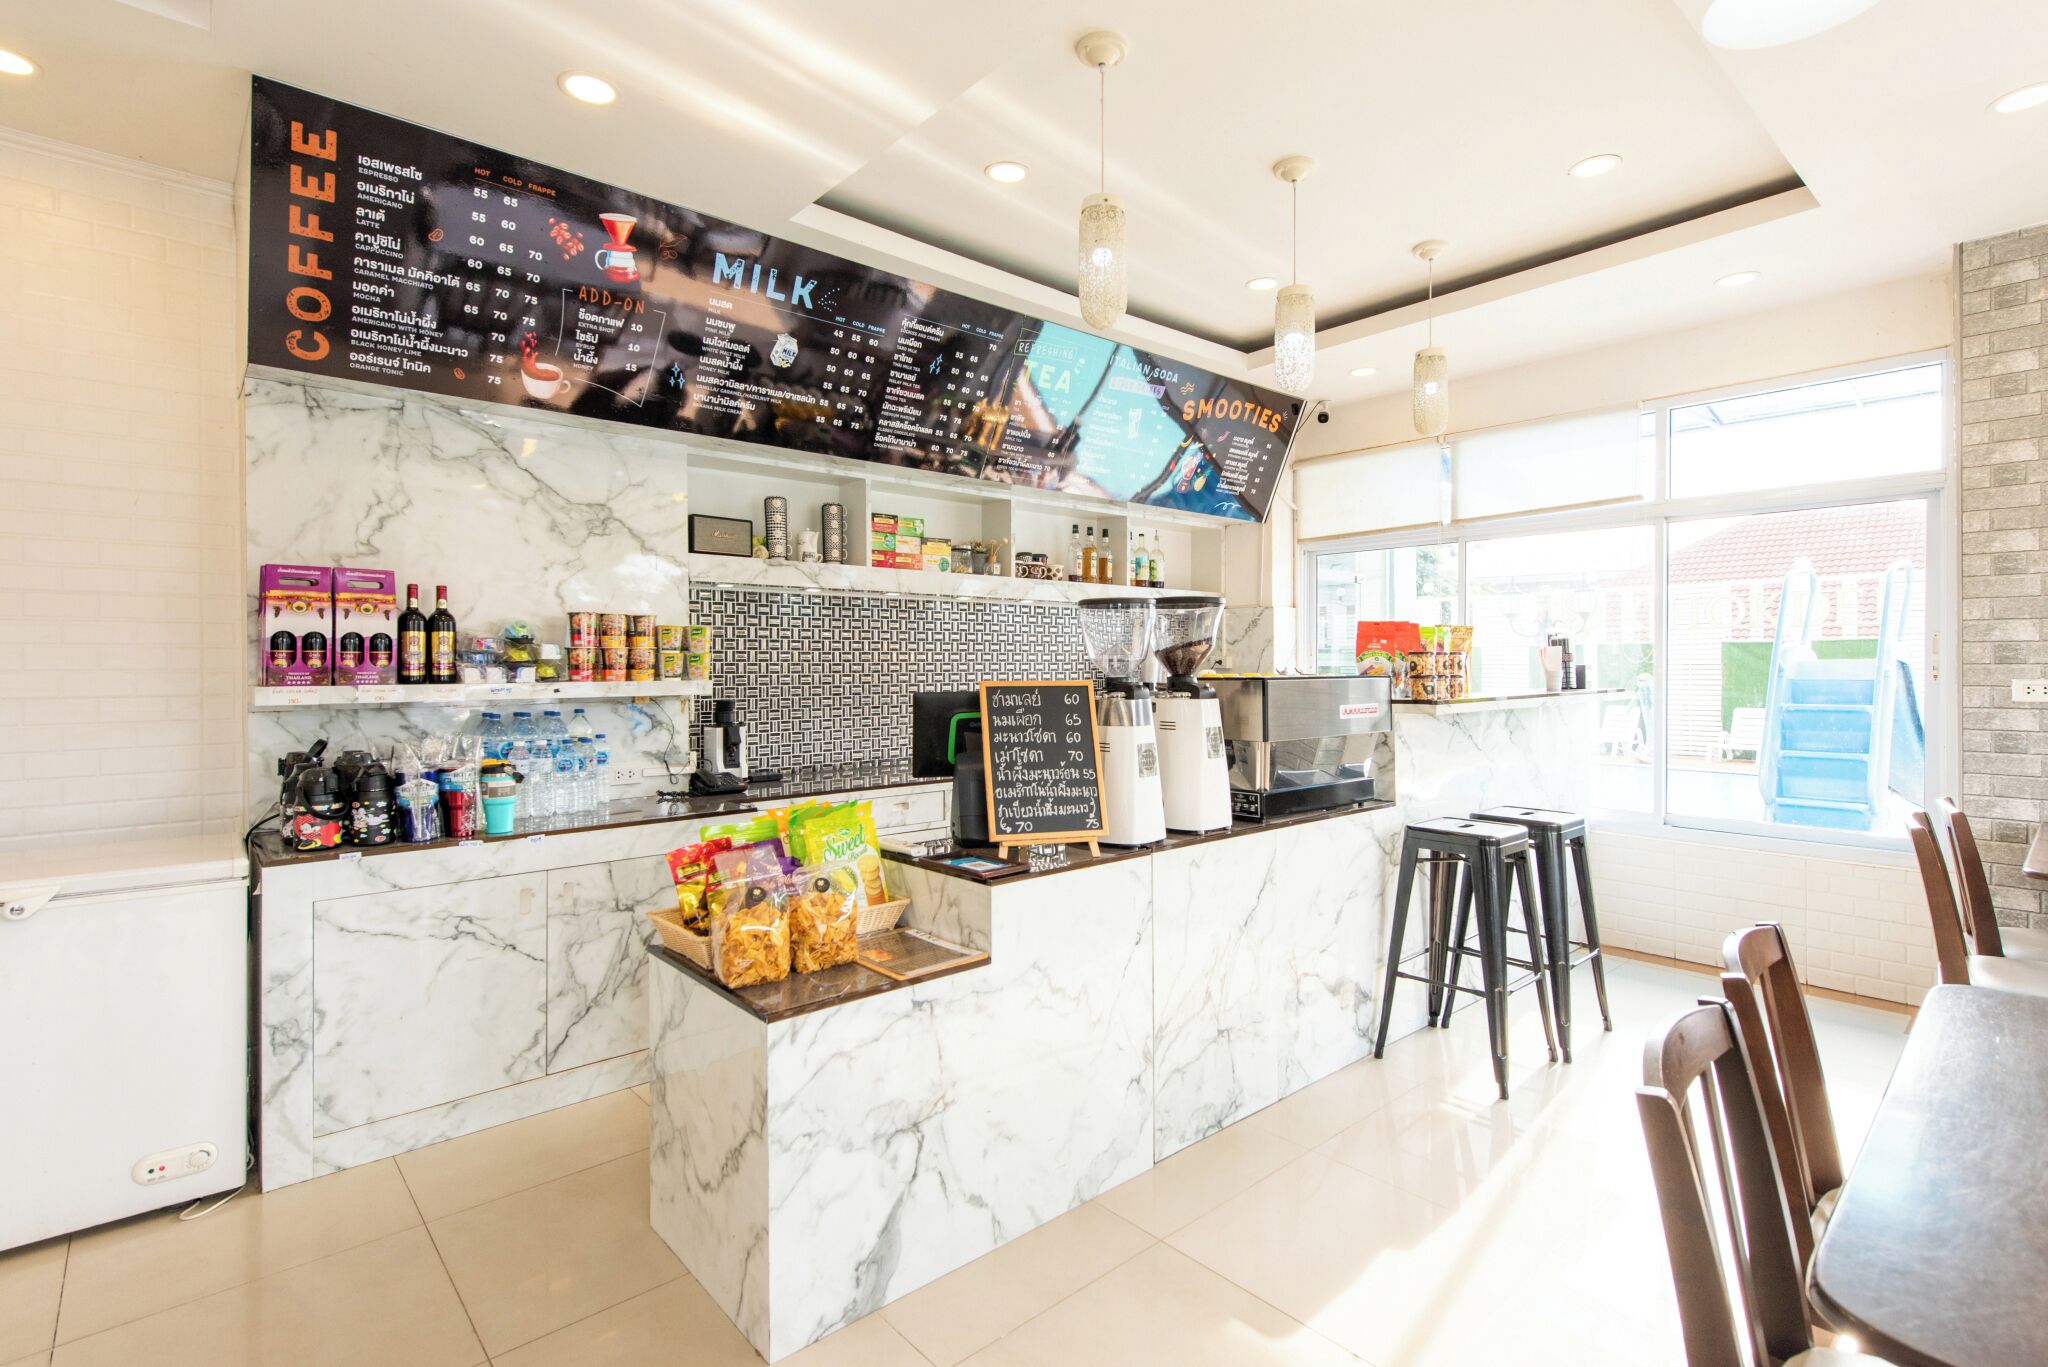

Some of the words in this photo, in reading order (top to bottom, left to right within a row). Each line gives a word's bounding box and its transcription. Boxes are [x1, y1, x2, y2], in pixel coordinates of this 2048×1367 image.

[358, 167, 399, 183] ESPRESSO
[358, 155, 422, 181] เอสเพรสโซ
[473, 188, 488, 199] 55
[503, 196, 518, 207] 65
[474, 167, 491, 177] HOT
[502, 176, 522, 186] COLD
[528, 183, 556, 196] FRAPPE
[357, 193, 403, 209] AMERICANO
[357, 181, 415, 204] อเมริกาโน่
[472, 212, 486, 223] 55
[501, 220, 516, 230] 60
[356, 218, 380, 229] LATTE
[286, 121, 337, 361] COFFEE
[356, 207, 386, 221] ลาเต้
[469, 236, 484, 246] 60
[499, 243, 514, 254] 65
[528, 250, 543, 260] 70
[355, 244, 404, 259] CAPPUCCINO
[355, 232, 401, 250] คาปูชิโน่
[467, 259, 482, 270] 60
[497, 265, 512, 276] 65
[526, 273, 540, 283] 70
[354, 268, 390, 280] CARAMEL
[392, 276, 434, 290] MACCHIATO
[354, 257, 405, 275] คาราเมล
[408, 267, 460, 288] มัคคิอาโต้
[465, 281, 480, 292] 65
[495, 289, 510, 298] 70
[524, 295, 538, 305] 75
[712, 252, 818, 309] MILK
[353, 292, 381, 303] MOCHA
[353, 281, 395, 297] มอคค่า
[464, 304, 479, 315] 65
[493, 311, 508, 321] 70
[522, 317, 535, 326] 75
[579, 286, 645, 314] ADD-ON
[351, 305, 436, 329] อเมริกาโน่น้ำผึ้ง
[491, 332, 506, 342] 70
[351, 316, 396, 329] AMERICANO
[398, 324, 417, 333] WITH
[419, 328, 444, 338] HONEY
[578, 322, 597, 330] EXTRA
[630, 323, 643, 332] 10
[868, 324, 886, 333] FRAPPE
[350, 328, 468, 357] อเมริกาโน่น้ำผึ้งมะนาว
[489, 354, 503, 363] 75
[351, 340, 375, 348] BLACK
[377, 344, 402, 353] HONEY
[834, 330, 843, 338] 45
[852, 334, 861, 342] 55
[869, 339, 879, 347] 60
[783, 348, 796, 357] MILK
[830, 347, 840, 355] 50
[989, 343, 997, 352] 70
[625, 363, 637, 371] 15
[970, 355, 978, 363] 65
[350, 362, 380, 372] ORANGE
[382, 367, 404, 376] TONIC
[403, 359, 431, 373] โทนิค
[487, 375, 502, 385] 75
[827, 365, 836, 373] 50
[844, 369, 854, 377] 60
[951, 367, 960, 375] 50
[1023, 360, 1070, 394] TEA
[1110, 355, 1151, 375] ITALIAN
[1153, 368, 1178, 383] SODA
[823, 382, 833, 390] 55
[840, 386, 850, 394] 65
[858, 389, 867, 397] 70
[976, 390, 984, 398] 65
[820, 398, 829, 406] 55
[837, 402, 846, 410] 65
[854, 406, 863, 414] 75
[816, 416, 826, 424] 55
[833, 419, 843, 427] 65
[850, 422, 859, 430] 75
[1182, 399, 1282, 433] SMOOTIES
[935, 429, 943, 437] 55
[931, 444, 940, 452] 60
[992, 688, 1041, 707] ชามาเลย์
[1064, 693, 1080, 704] 60
[992, 708, 1042, 726] นมเผือก
[1065, 714, 1081, 726] 65
[994, 728, 1057, 743] มะนาวโซดา
[1066, 732, 1081, 743] 60
[1068, 751, 1083, 761] 70
[1083, 769, 1095, 779] 55
[1016, 822, 1032, 832] 70
[1086, 819, 1099, 828] 75
[823, 823, 866, 860] Sweet
